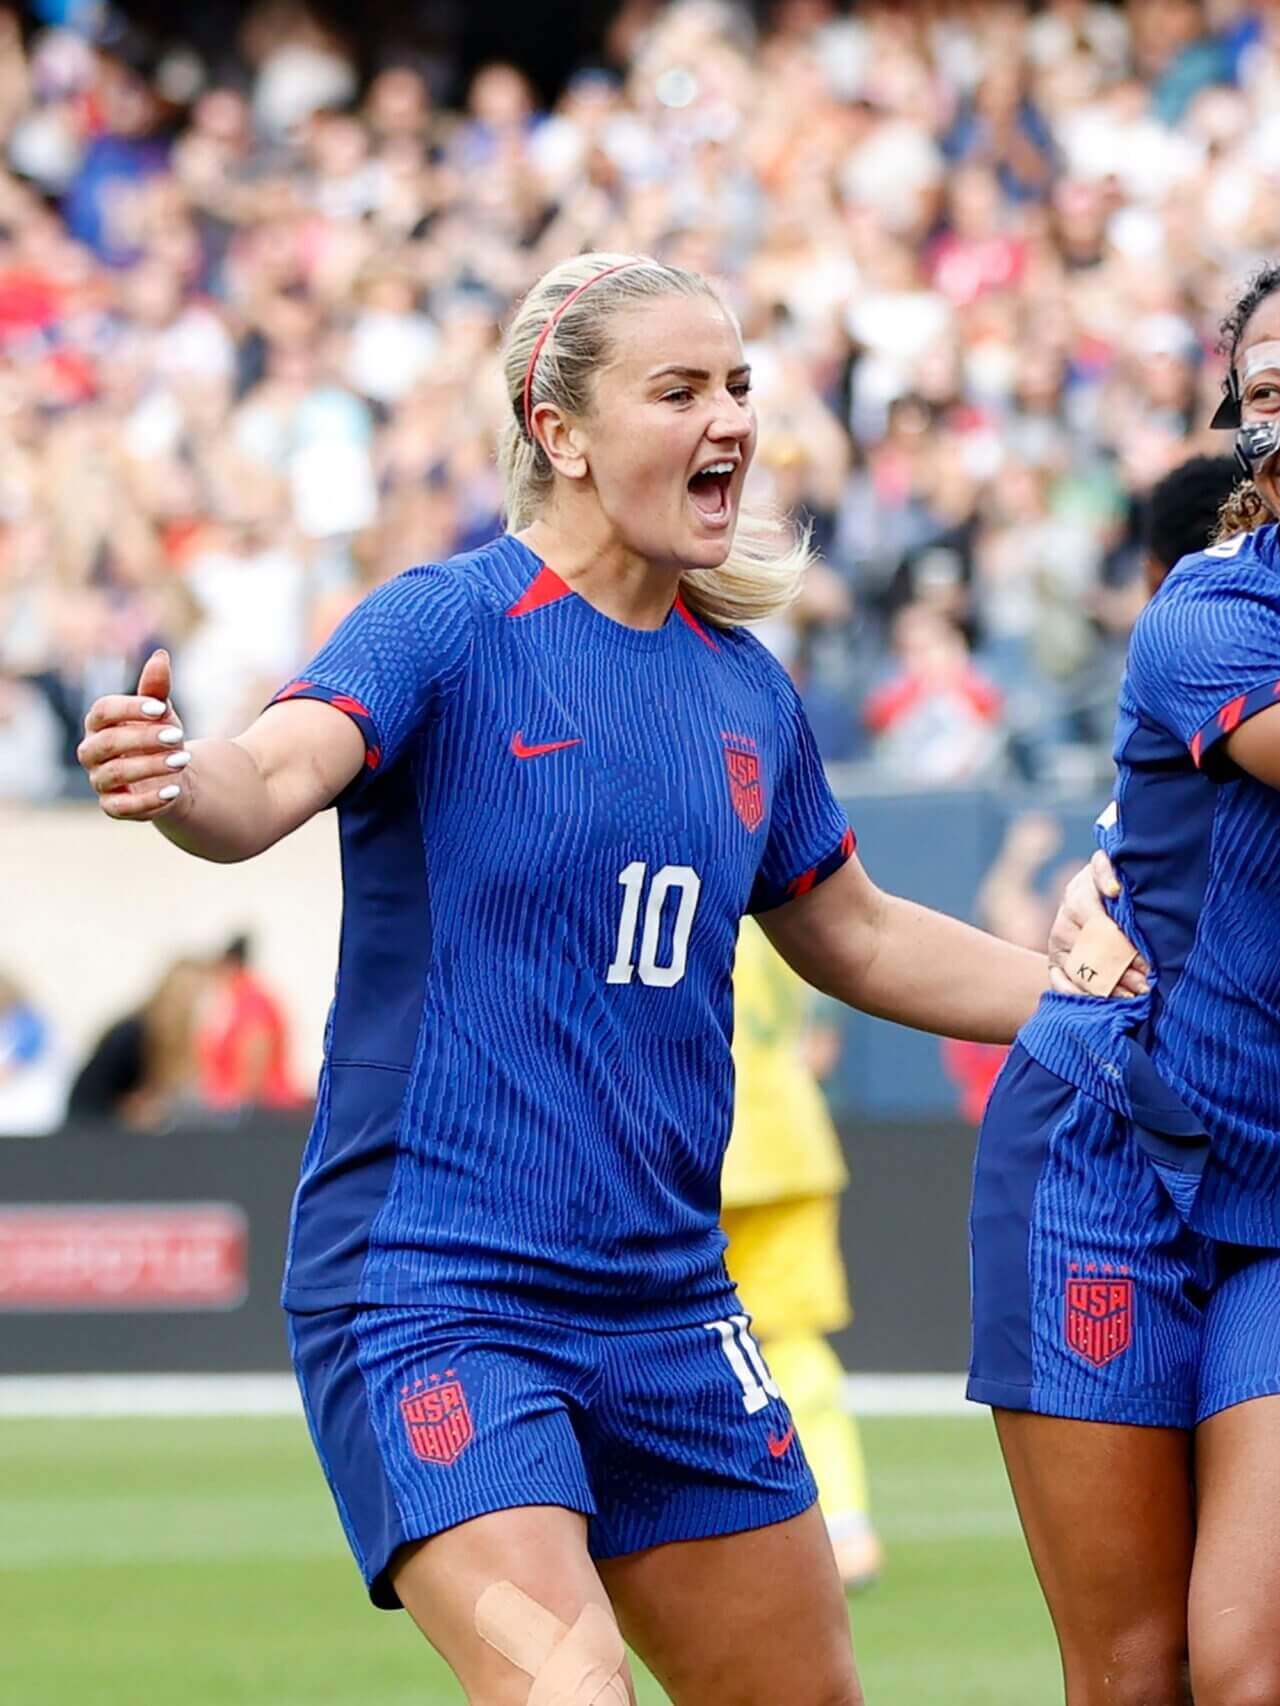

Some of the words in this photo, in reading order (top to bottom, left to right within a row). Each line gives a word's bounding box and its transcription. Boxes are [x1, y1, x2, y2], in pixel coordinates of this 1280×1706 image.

[727, 754, 758, 784] USA
[607, 862, 700, 987] 10
[1077, 963, 1099, 983] KT
[1070, 1284, 1126, 1317] USA
[405, 1384, 461, 1422] USA
